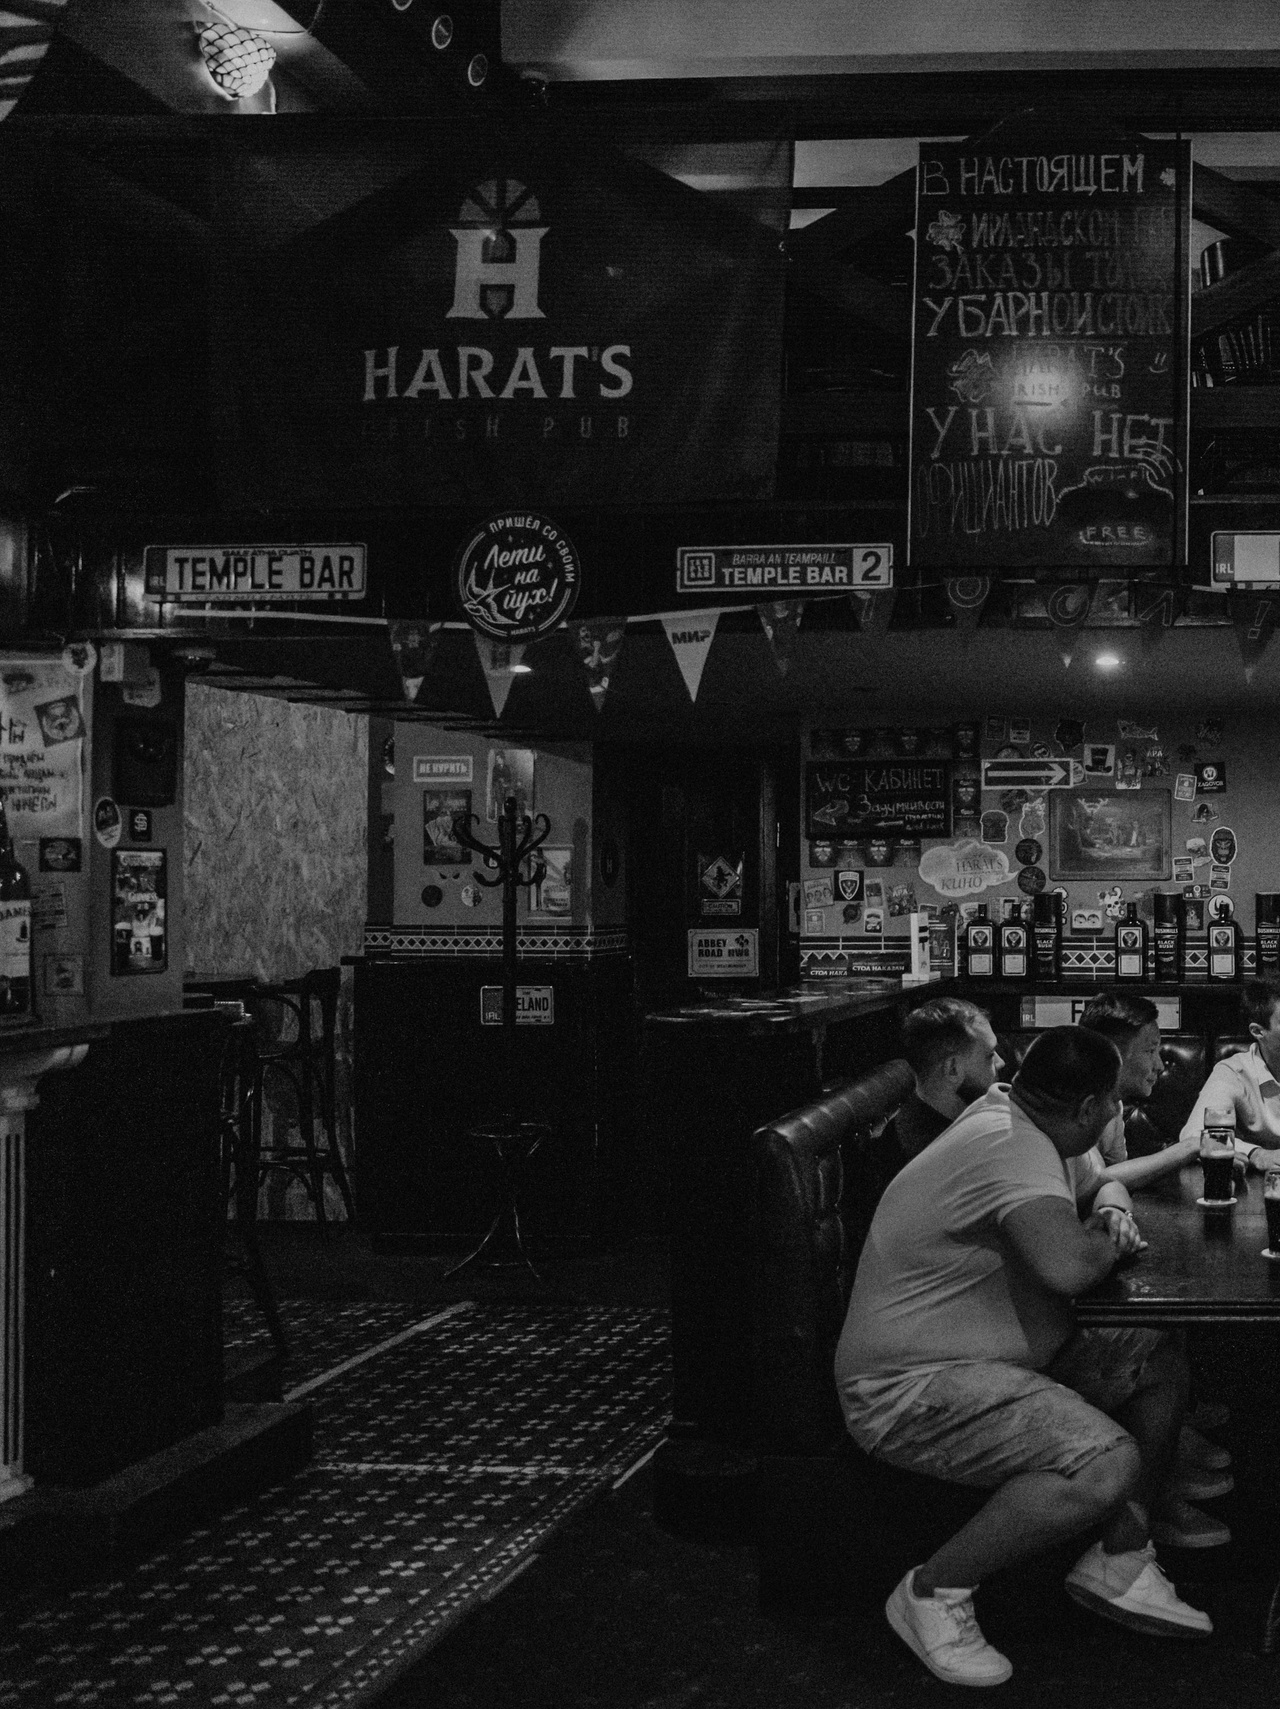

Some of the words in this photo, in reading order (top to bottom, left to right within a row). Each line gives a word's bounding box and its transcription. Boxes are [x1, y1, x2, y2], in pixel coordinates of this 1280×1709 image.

[921, 161, 950, 196] В
[959, 153, 1145, 196] НАСТОЯЩЕМ
[929, 251, 1072, 290] ЗАКАЗЫ
[363, 344, 634, 401] HARAT'S
[967, 406, 1063, 457] НАС
[1092, 409, 1176, 461] НЕТ
[484, 544, 547, 570] Лети
[489, 515, 541, 533] ПРИШЁЛ
[542, 525, 558, 541] СО
[556, 540, 576, 582] СВОИМ
[174, 556, 284, 591] TEMPLE
[300, 555, 354, 590] BAR
[514, 568, 541, 585] на
[722, 566, 801, 585] TEMPLE
[806, 565, 849, 584] BAR
[861, 550, 883, 582] 2
[1215, 563, 1234, 575] IRL
[503, 577, 559, 620] йух!
[698, 938, 727, 948] ABBEY
[698, 948, 723, 957] ROAD
[516, 997, 549, 1011] ELAND
